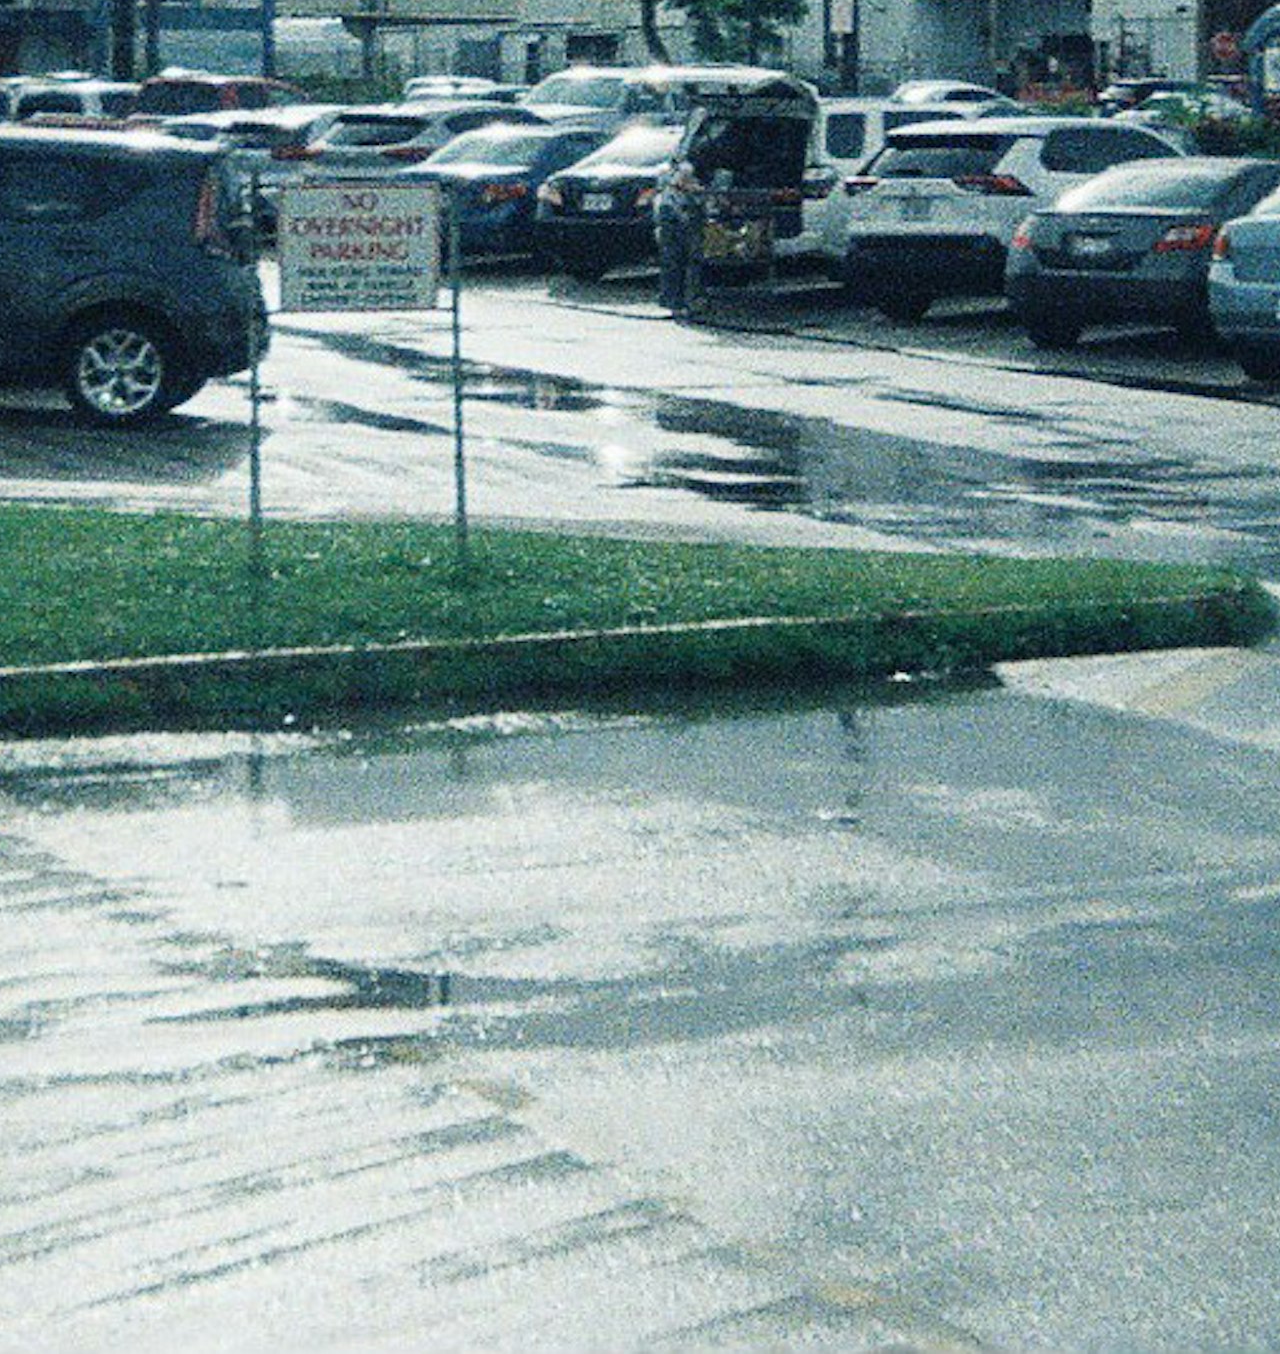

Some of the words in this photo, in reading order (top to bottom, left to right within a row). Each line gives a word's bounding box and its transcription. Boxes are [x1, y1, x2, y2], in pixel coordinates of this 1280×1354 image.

[341, 192, 380, 211] NO
[289, 216, 423, 236] OVERNIGHT
[310, 241, 410, 260] PARKING
